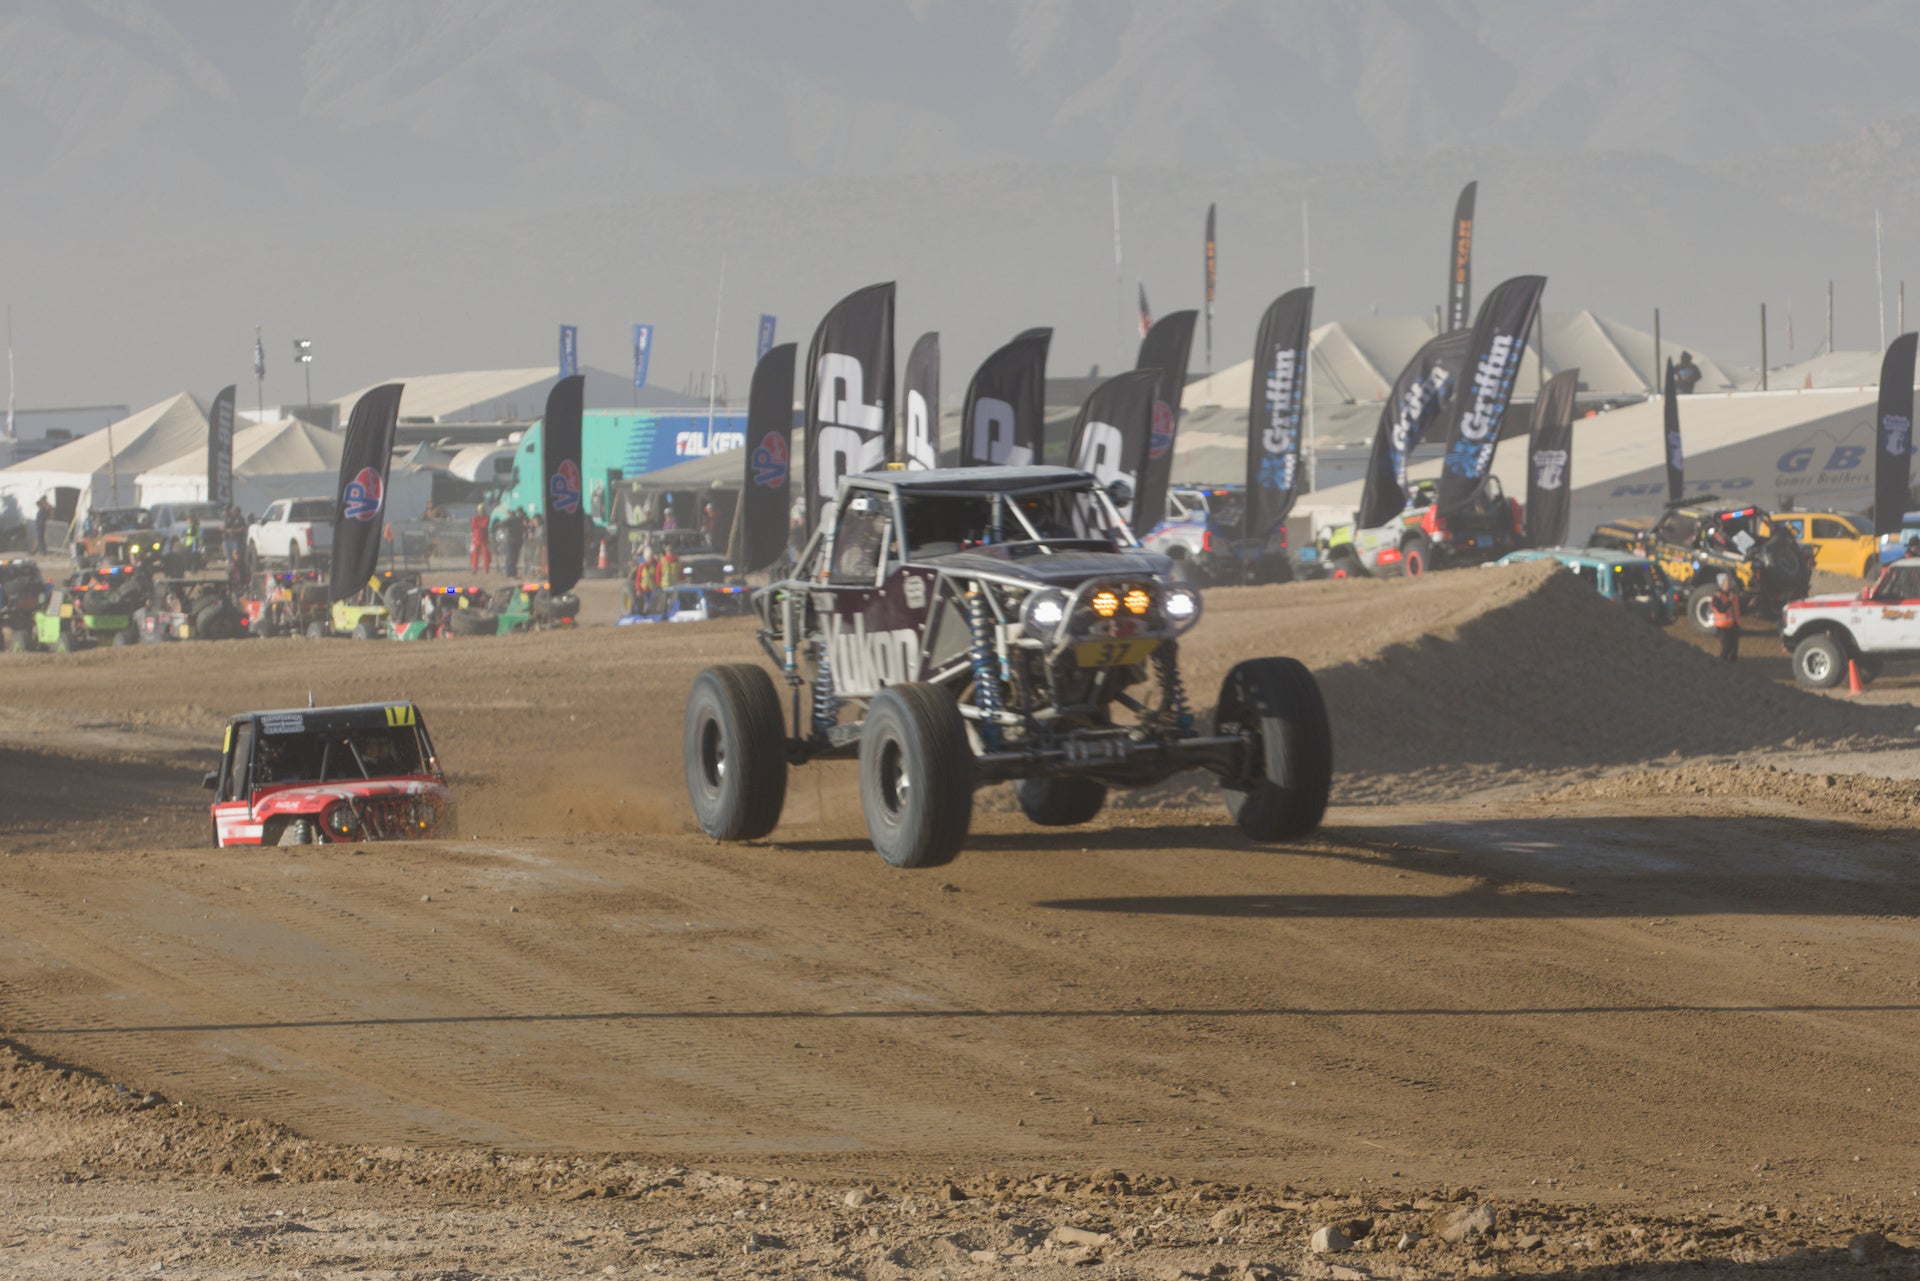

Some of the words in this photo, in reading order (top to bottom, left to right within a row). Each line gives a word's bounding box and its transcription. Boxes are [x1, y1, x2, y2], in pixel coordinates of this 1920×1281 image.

[1262, 348, 1296, 455] Griffin
[1460, 331, 1513, 441] Griffin
[751, 446, 787, 487] VP
[343, 480, 381, 519] VP
[550, 473, 579, 511] VP
[1610, 476, 1756, 497] NITO
[818, 612, 920, 696] Yukon
[1097, 643, 1132, 666] 37
[390, 706, 410, 724] 17
